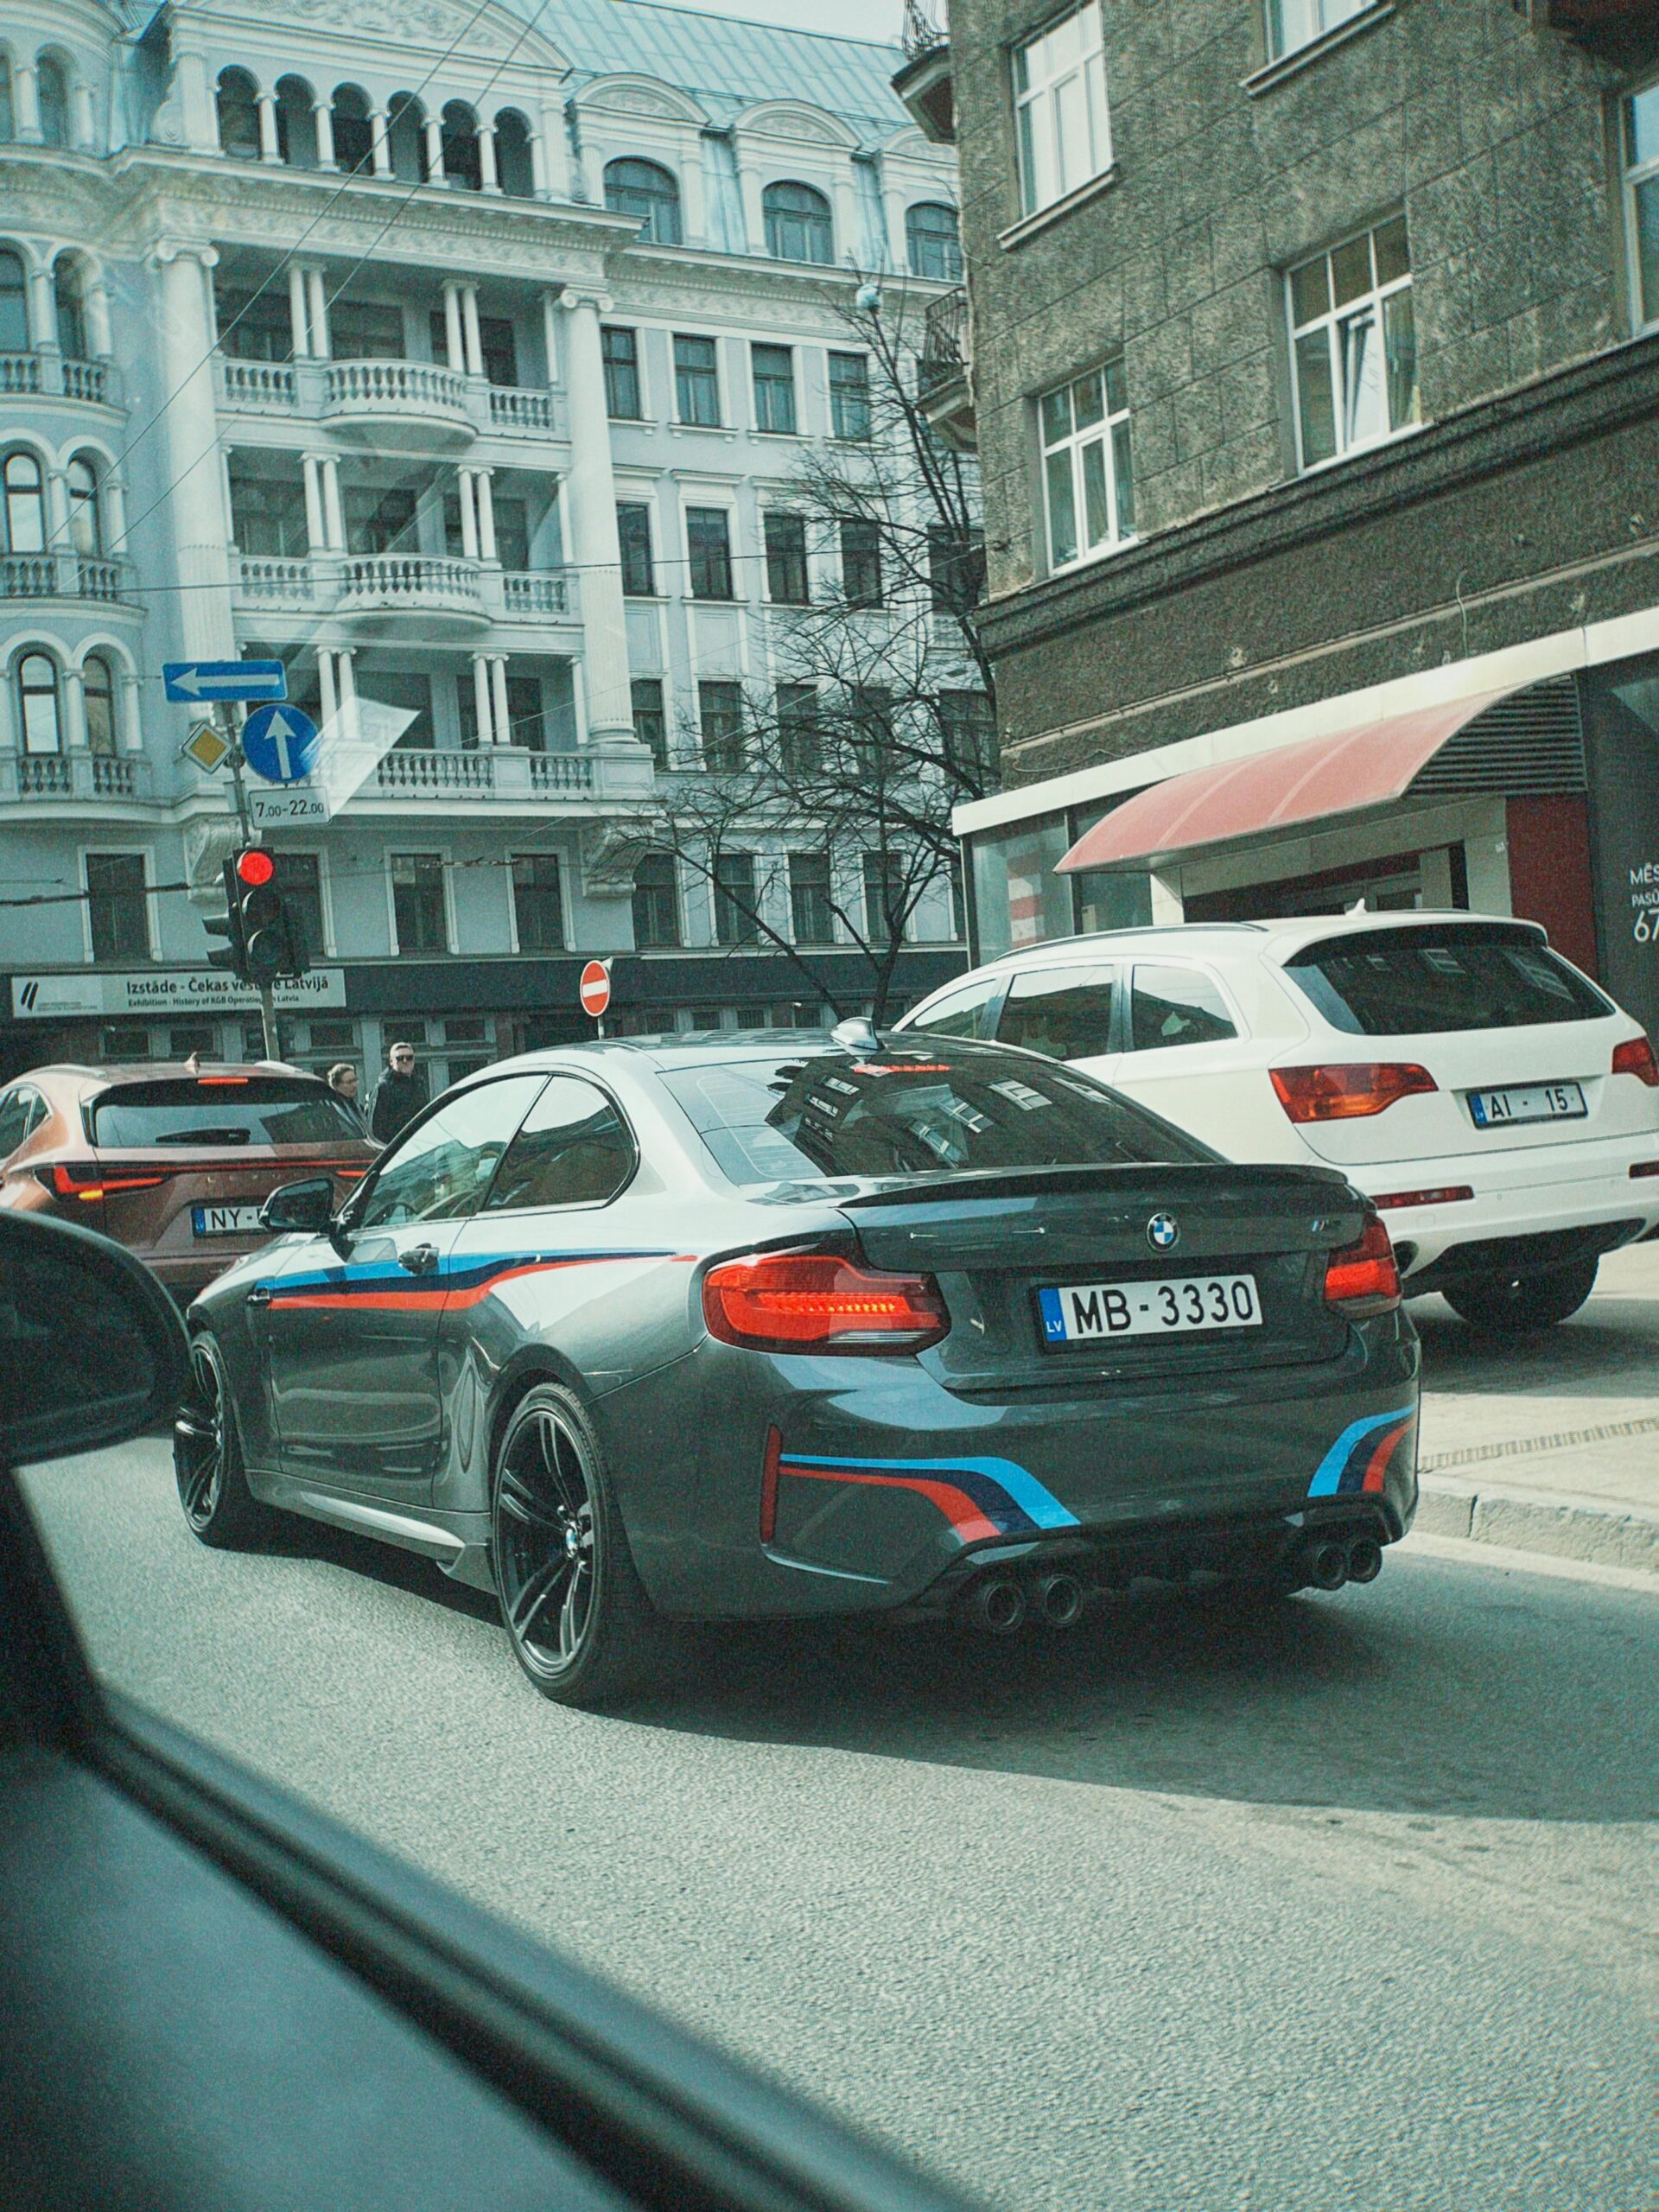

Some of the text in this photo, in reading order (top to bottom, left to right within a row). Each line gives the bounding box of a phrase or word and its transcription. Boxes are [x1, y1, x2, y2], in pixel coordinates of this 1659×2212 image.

[188, 976, 229, 992] Čekas
[1071, 1281, 1253, 1333] MB-3330
[1046, 1320, 1062, 1332] LV
